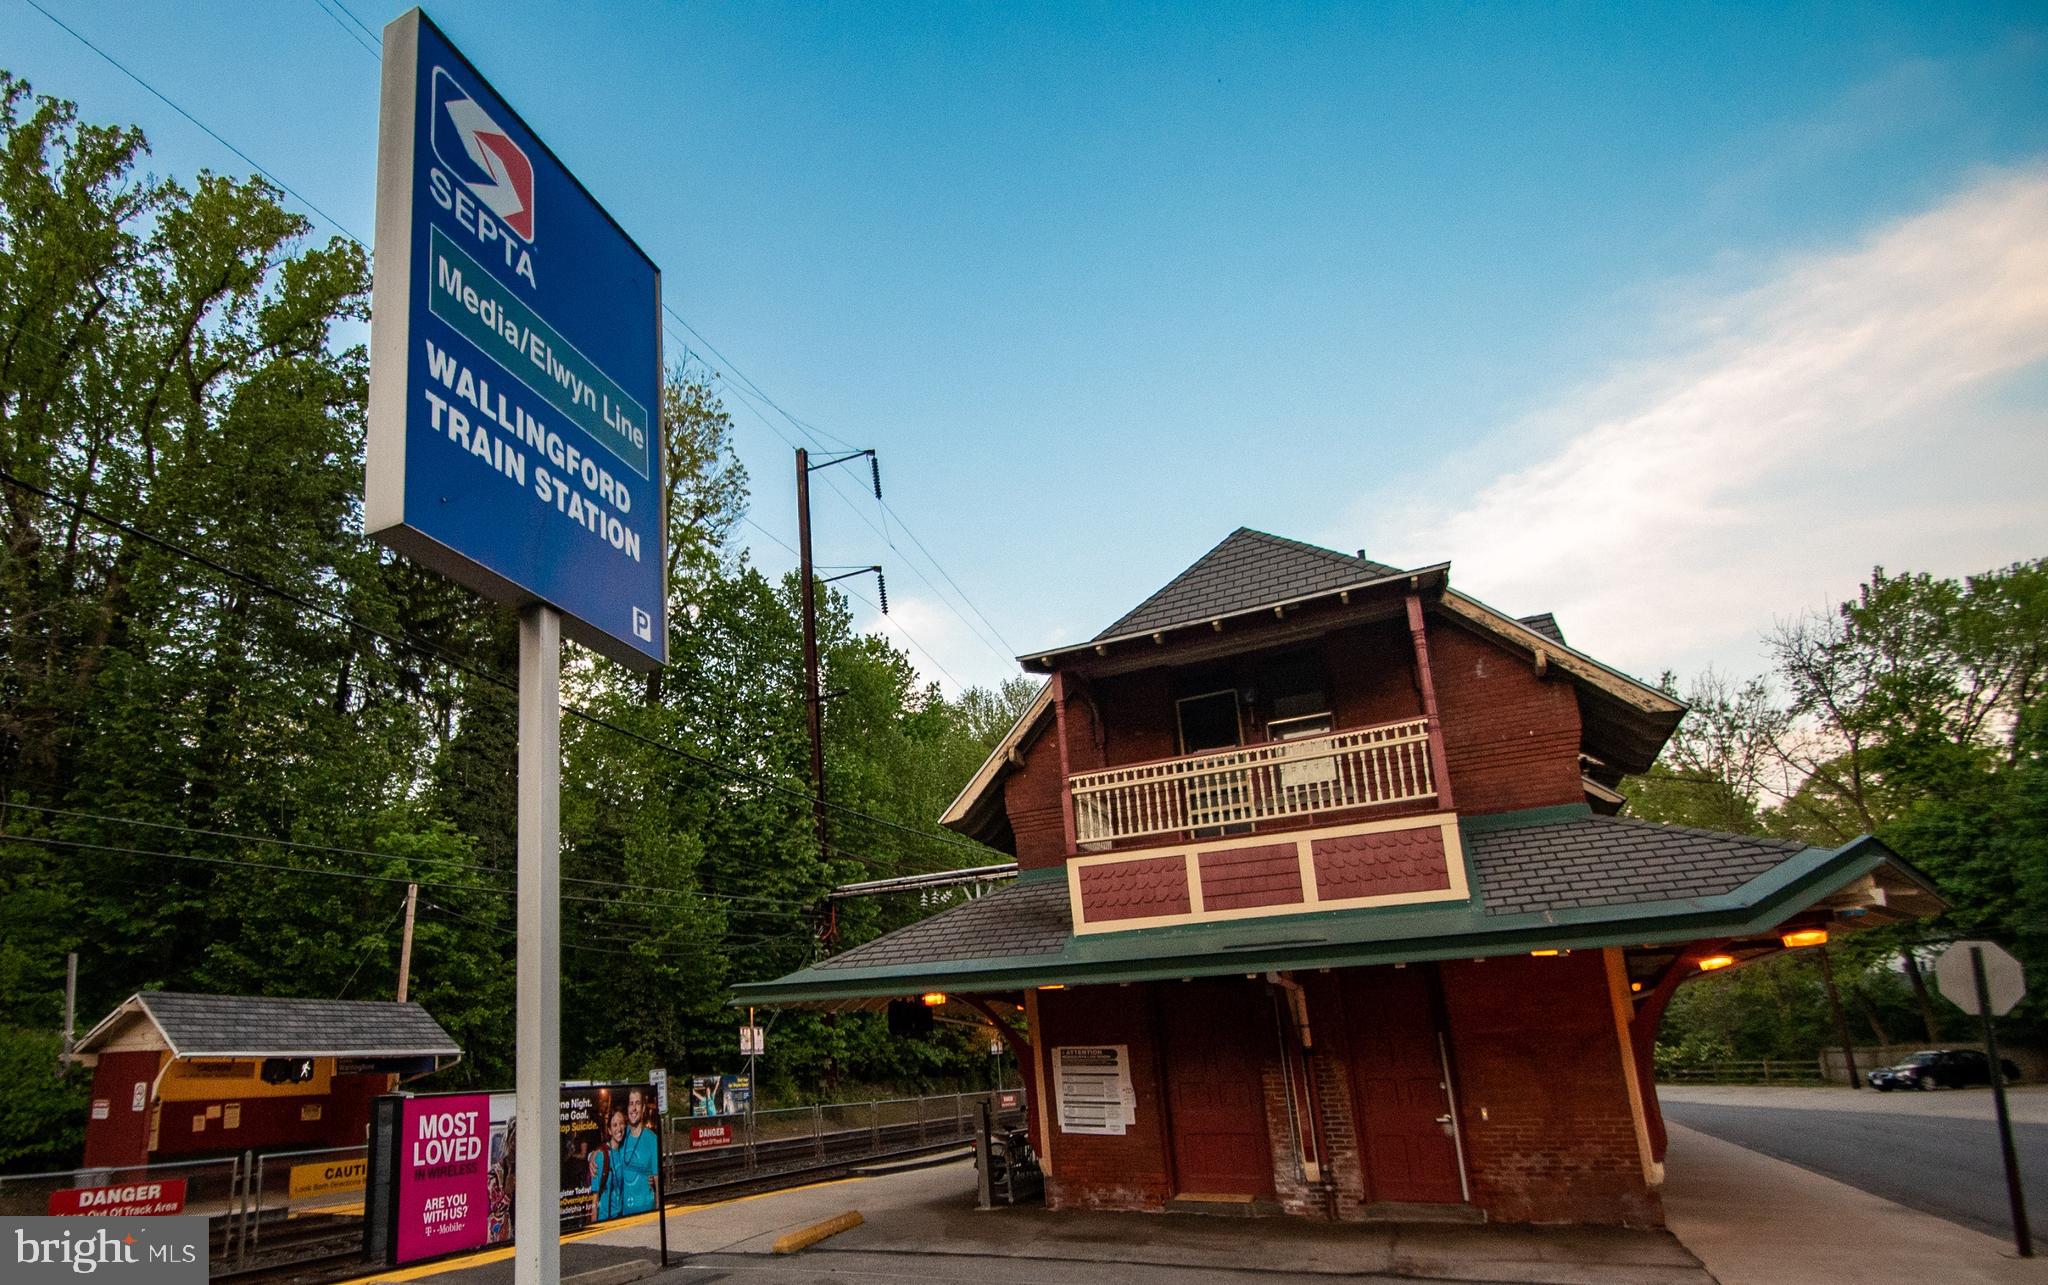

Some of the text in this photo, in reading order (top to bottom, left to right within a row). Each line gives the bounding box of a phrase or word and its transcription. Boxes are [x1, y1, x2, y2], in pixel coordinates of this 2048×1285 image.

[430, 168, 537, 290] SEPTA
[438, 255, 644, 450] Media/Elwyn Line
[426, 339, 631, 514] WALLINGFORD
[425, 388, 640, 563] TRAIN STATION
[560, 1098, 593, 1110] ne Night.
[560, 1109, 589, 1121] ne Goal.
[419, 1112, 479, 1140] MOST
[571, 1120, 599, 1132] Suicide.
[698, 1127, 725, 1138] DANGER
[413, 1136, 482, 1167] LOVED
[324, 1164, 366, 1179] CAUTI
[414, 1162, 479, 1181] IN WIRELESS
[79, 1184, 162, 1208] DANGER
[425, 1193, 467, 1211] ARE YOU
[124, 1203, 153, 1216] Track
[154, 1201, 178, 1213] Area
[423, 1205, 469, 1224] WITH US?
